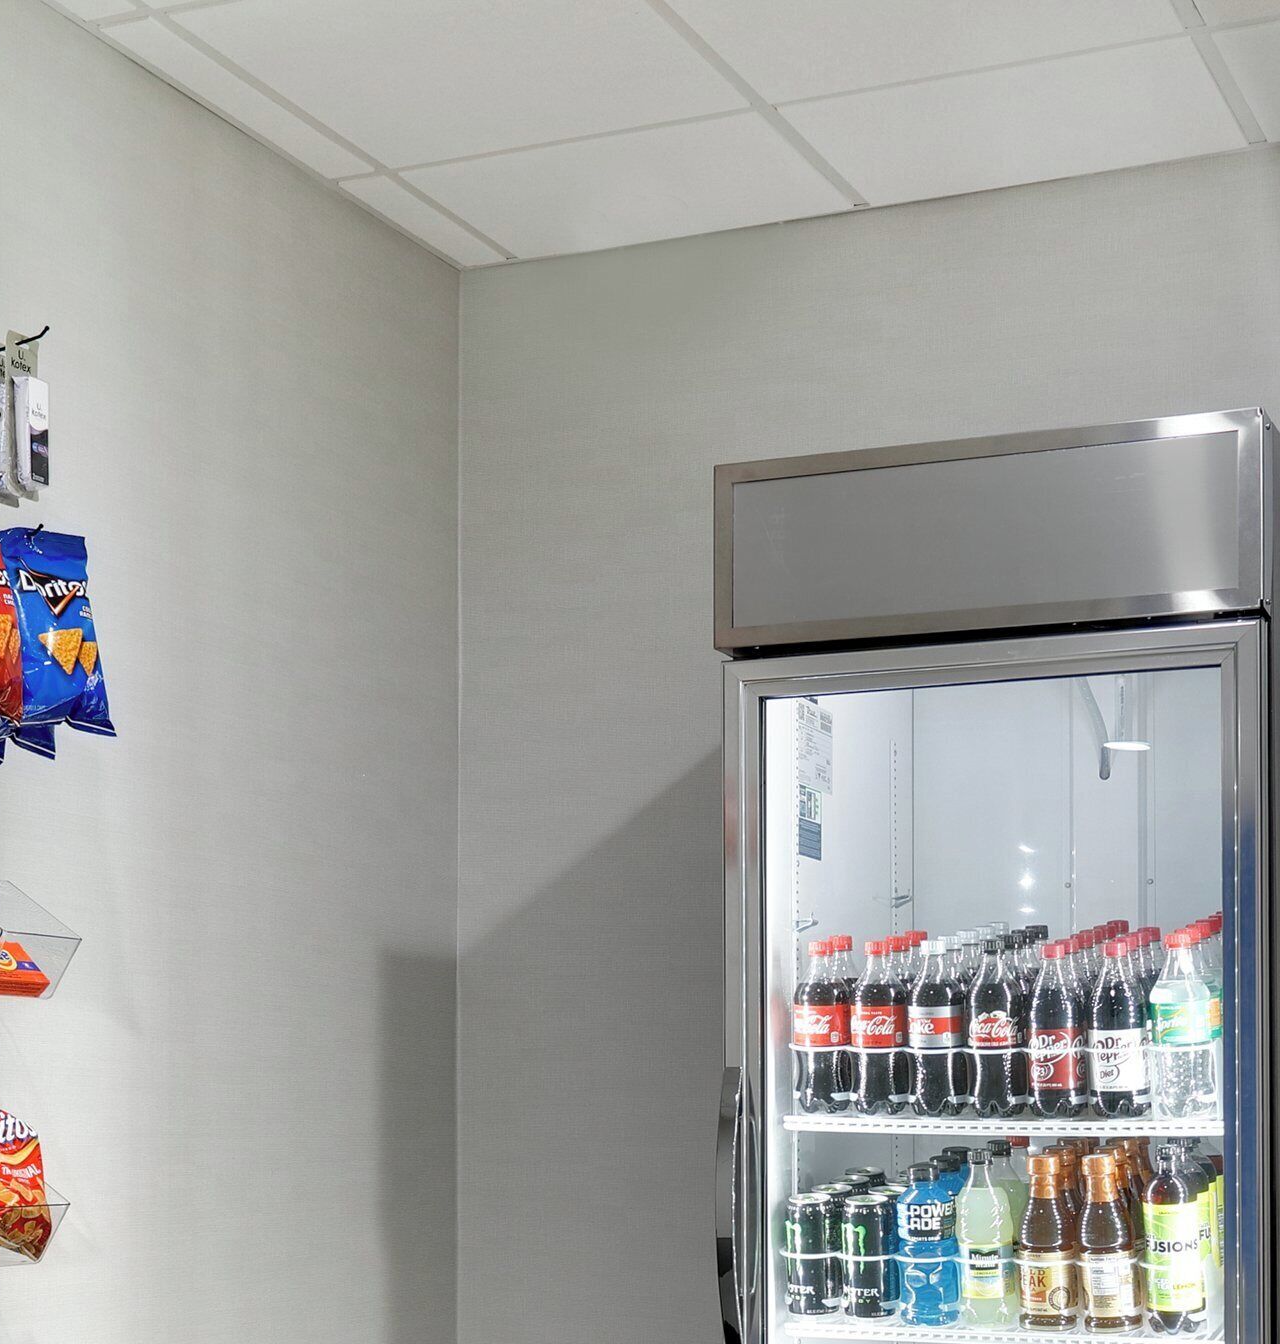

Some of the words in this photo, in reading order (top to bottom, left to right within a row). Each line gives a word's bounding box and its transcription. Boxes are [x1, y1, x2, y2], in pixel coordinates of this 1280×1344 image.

[10, 359, 32, 375] kotex
[969, 1015, 1019, 1039] Coca-Cola
[1039, 1033, 1056, 1048] Dr
[1103, 1035, 1122, 1050] Dr
[1099, 1068, 1115, 1081] Diet
[910, 1216, 942, 1231] ADE
[1145, 1238, 1199, 1253] FUSIONS
